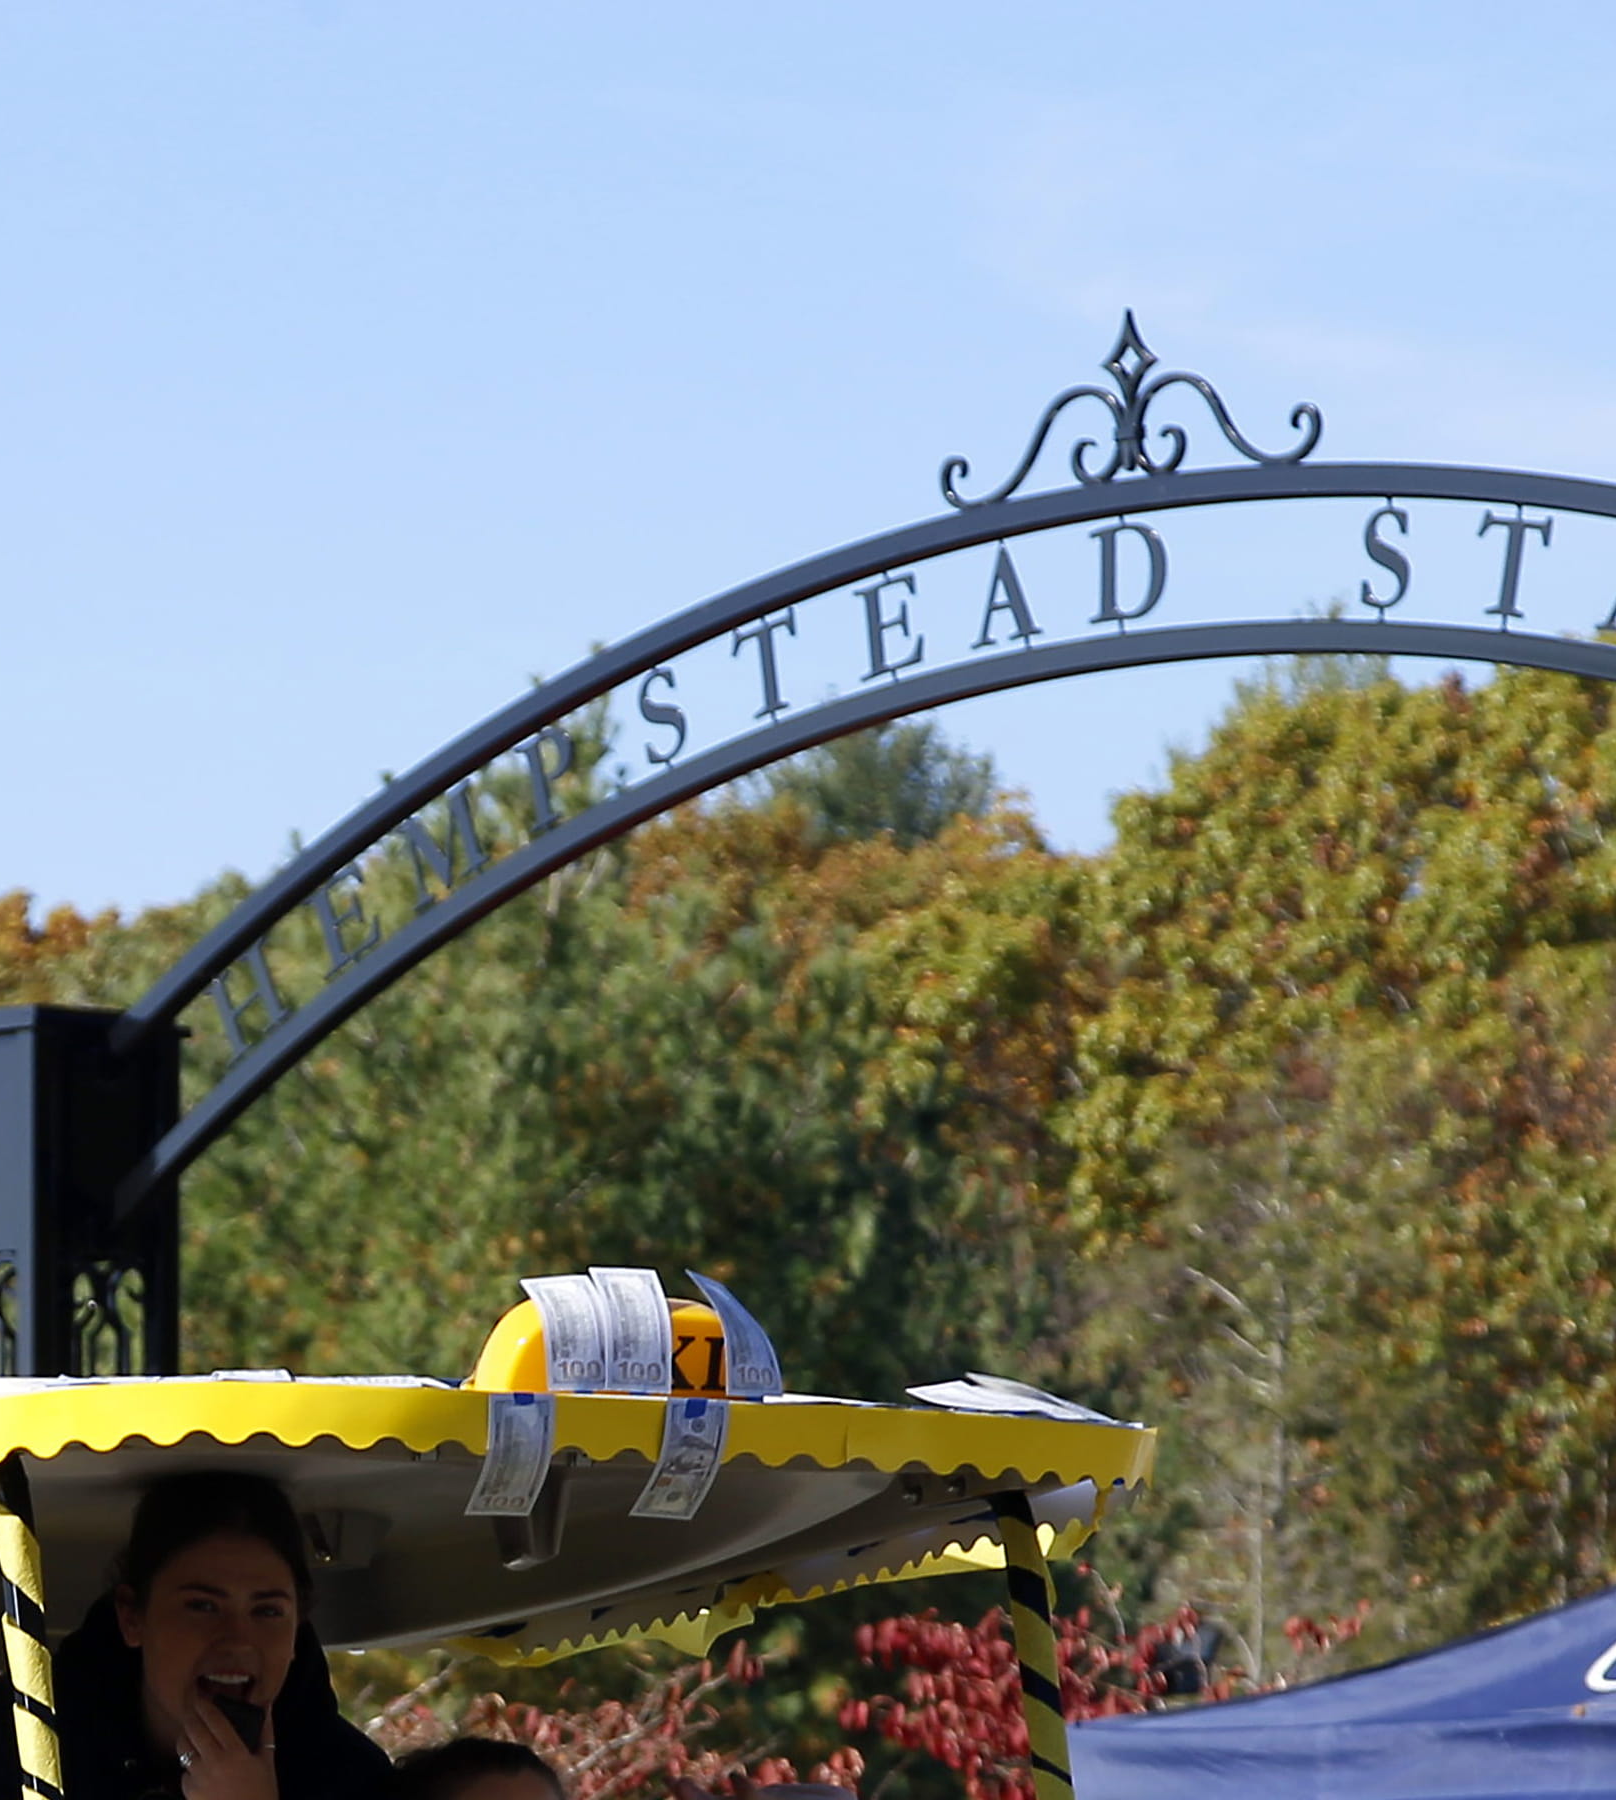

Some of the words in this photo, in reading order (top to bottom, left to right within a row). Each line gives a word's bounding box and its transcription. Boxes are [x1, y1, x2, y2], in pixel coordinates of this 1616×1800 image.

[204, 519, 1169, 1062] HEMPSTEAD
[557, 1360, 602, 1379] 100
[618, 1361, 662, 1381] 100
[737, 1366, 774, 1386] 100
